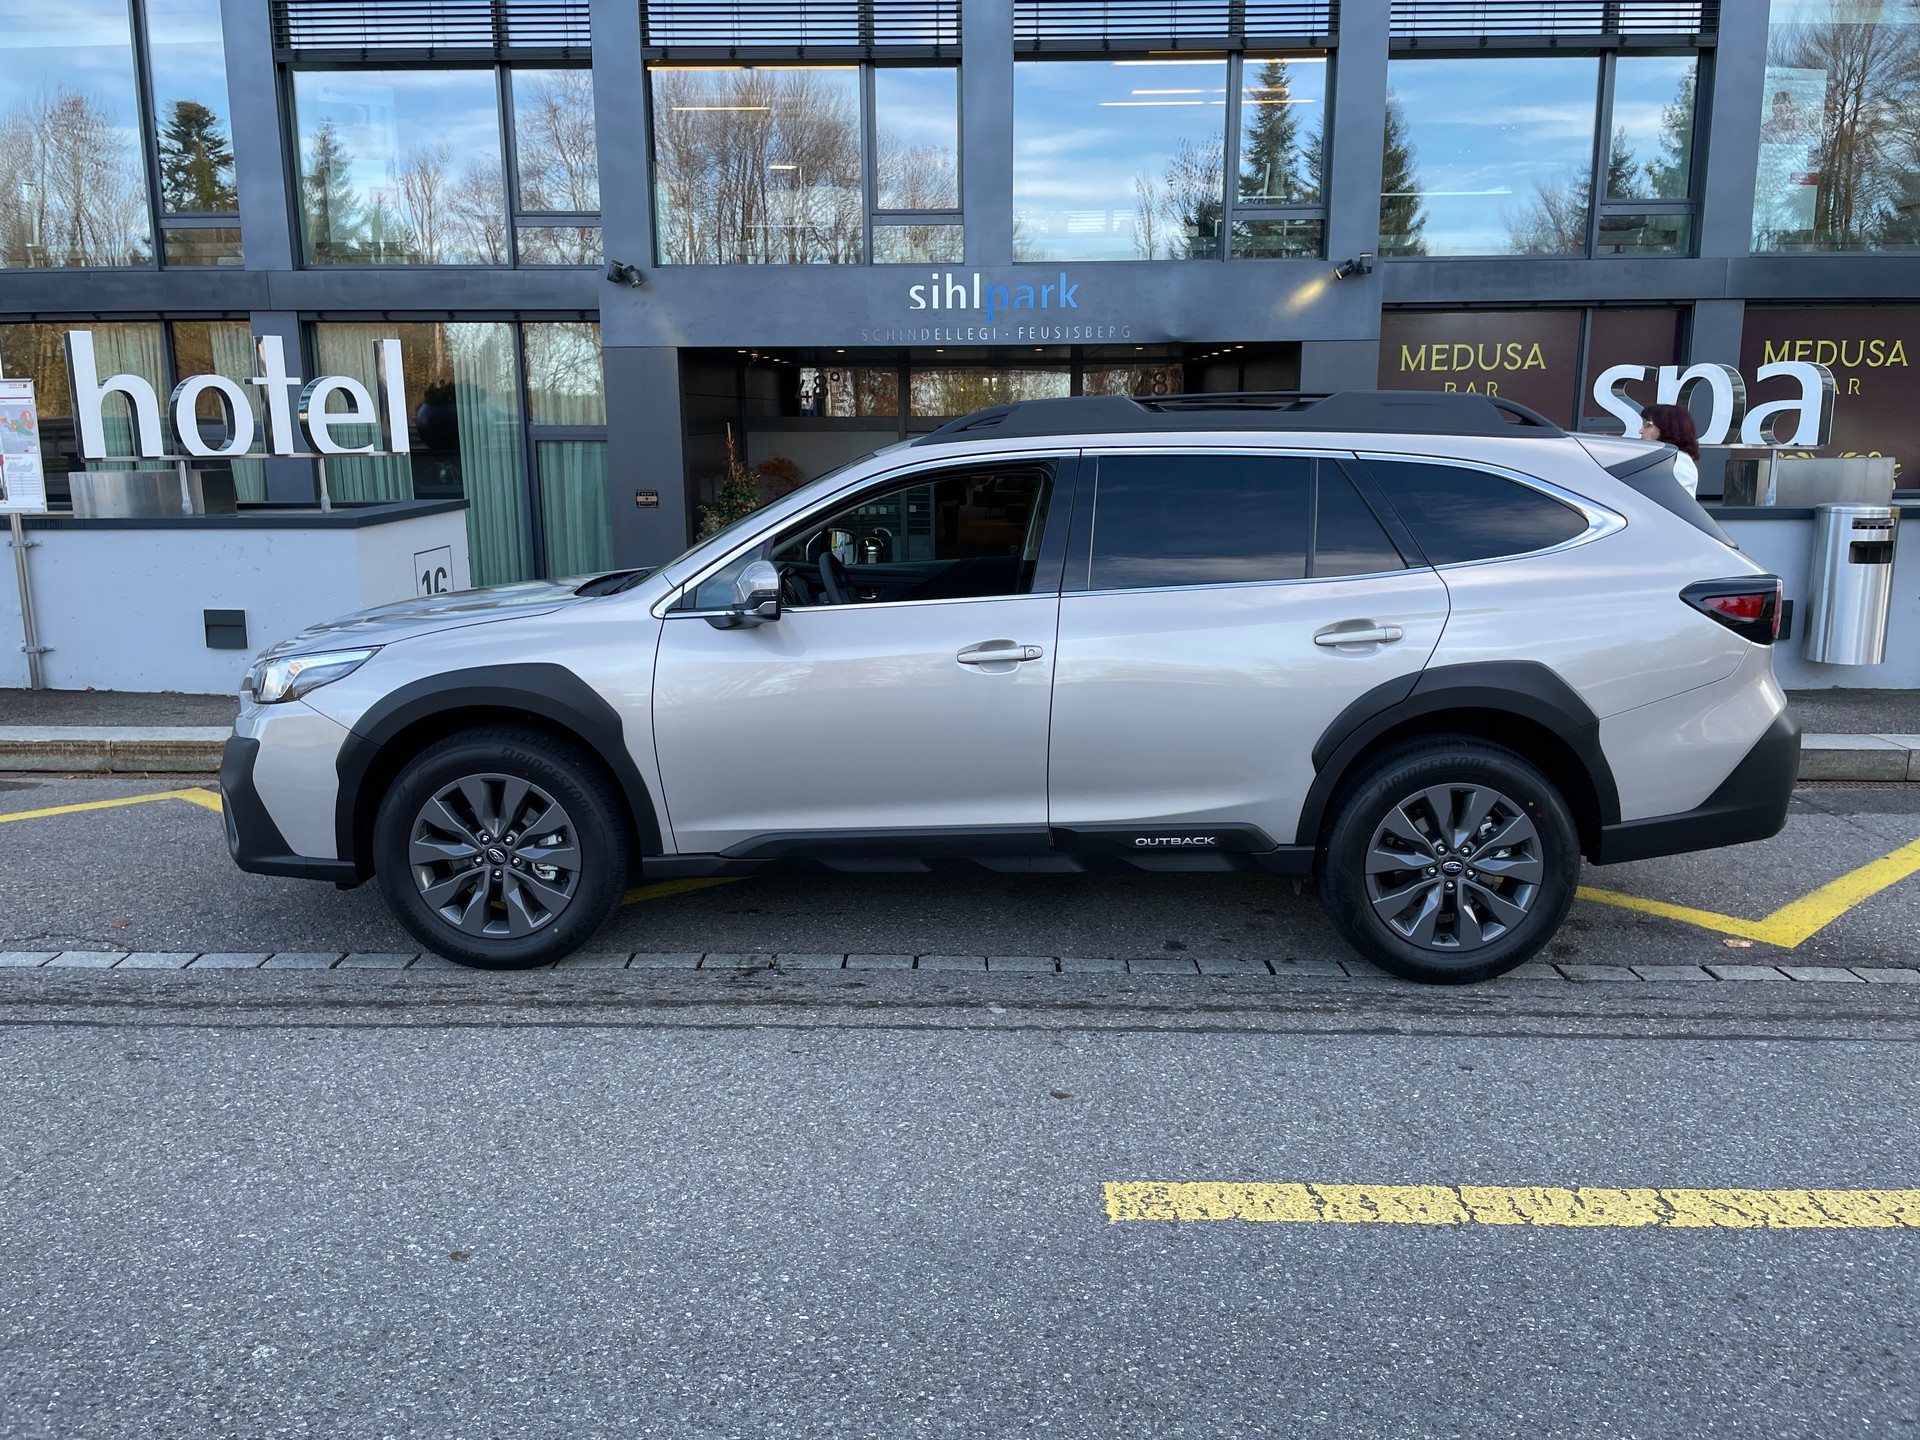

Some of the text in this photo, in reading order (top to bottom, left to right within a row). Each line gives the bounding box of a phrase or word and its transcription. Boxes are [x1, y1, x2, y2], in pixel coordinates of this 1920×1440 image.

[908, 272, 1080, 323] sihlpark
[861, 325, 1131, 343] SCHINDELLEGI FEUSISBERG
[1400, 342, 1547, 372] MEDUSA
[1763, 339, 1909, 368] MEDUSA
[64, 330, 410, 459] hotel
[1444, 381, 1499, 398] BAR
[498, 748, 595, 816] BRIDGESTONE
[1378, 756, 1492, 793] BRIDGESTONE
[1134, 836, 1216, 847] OUTBACK
